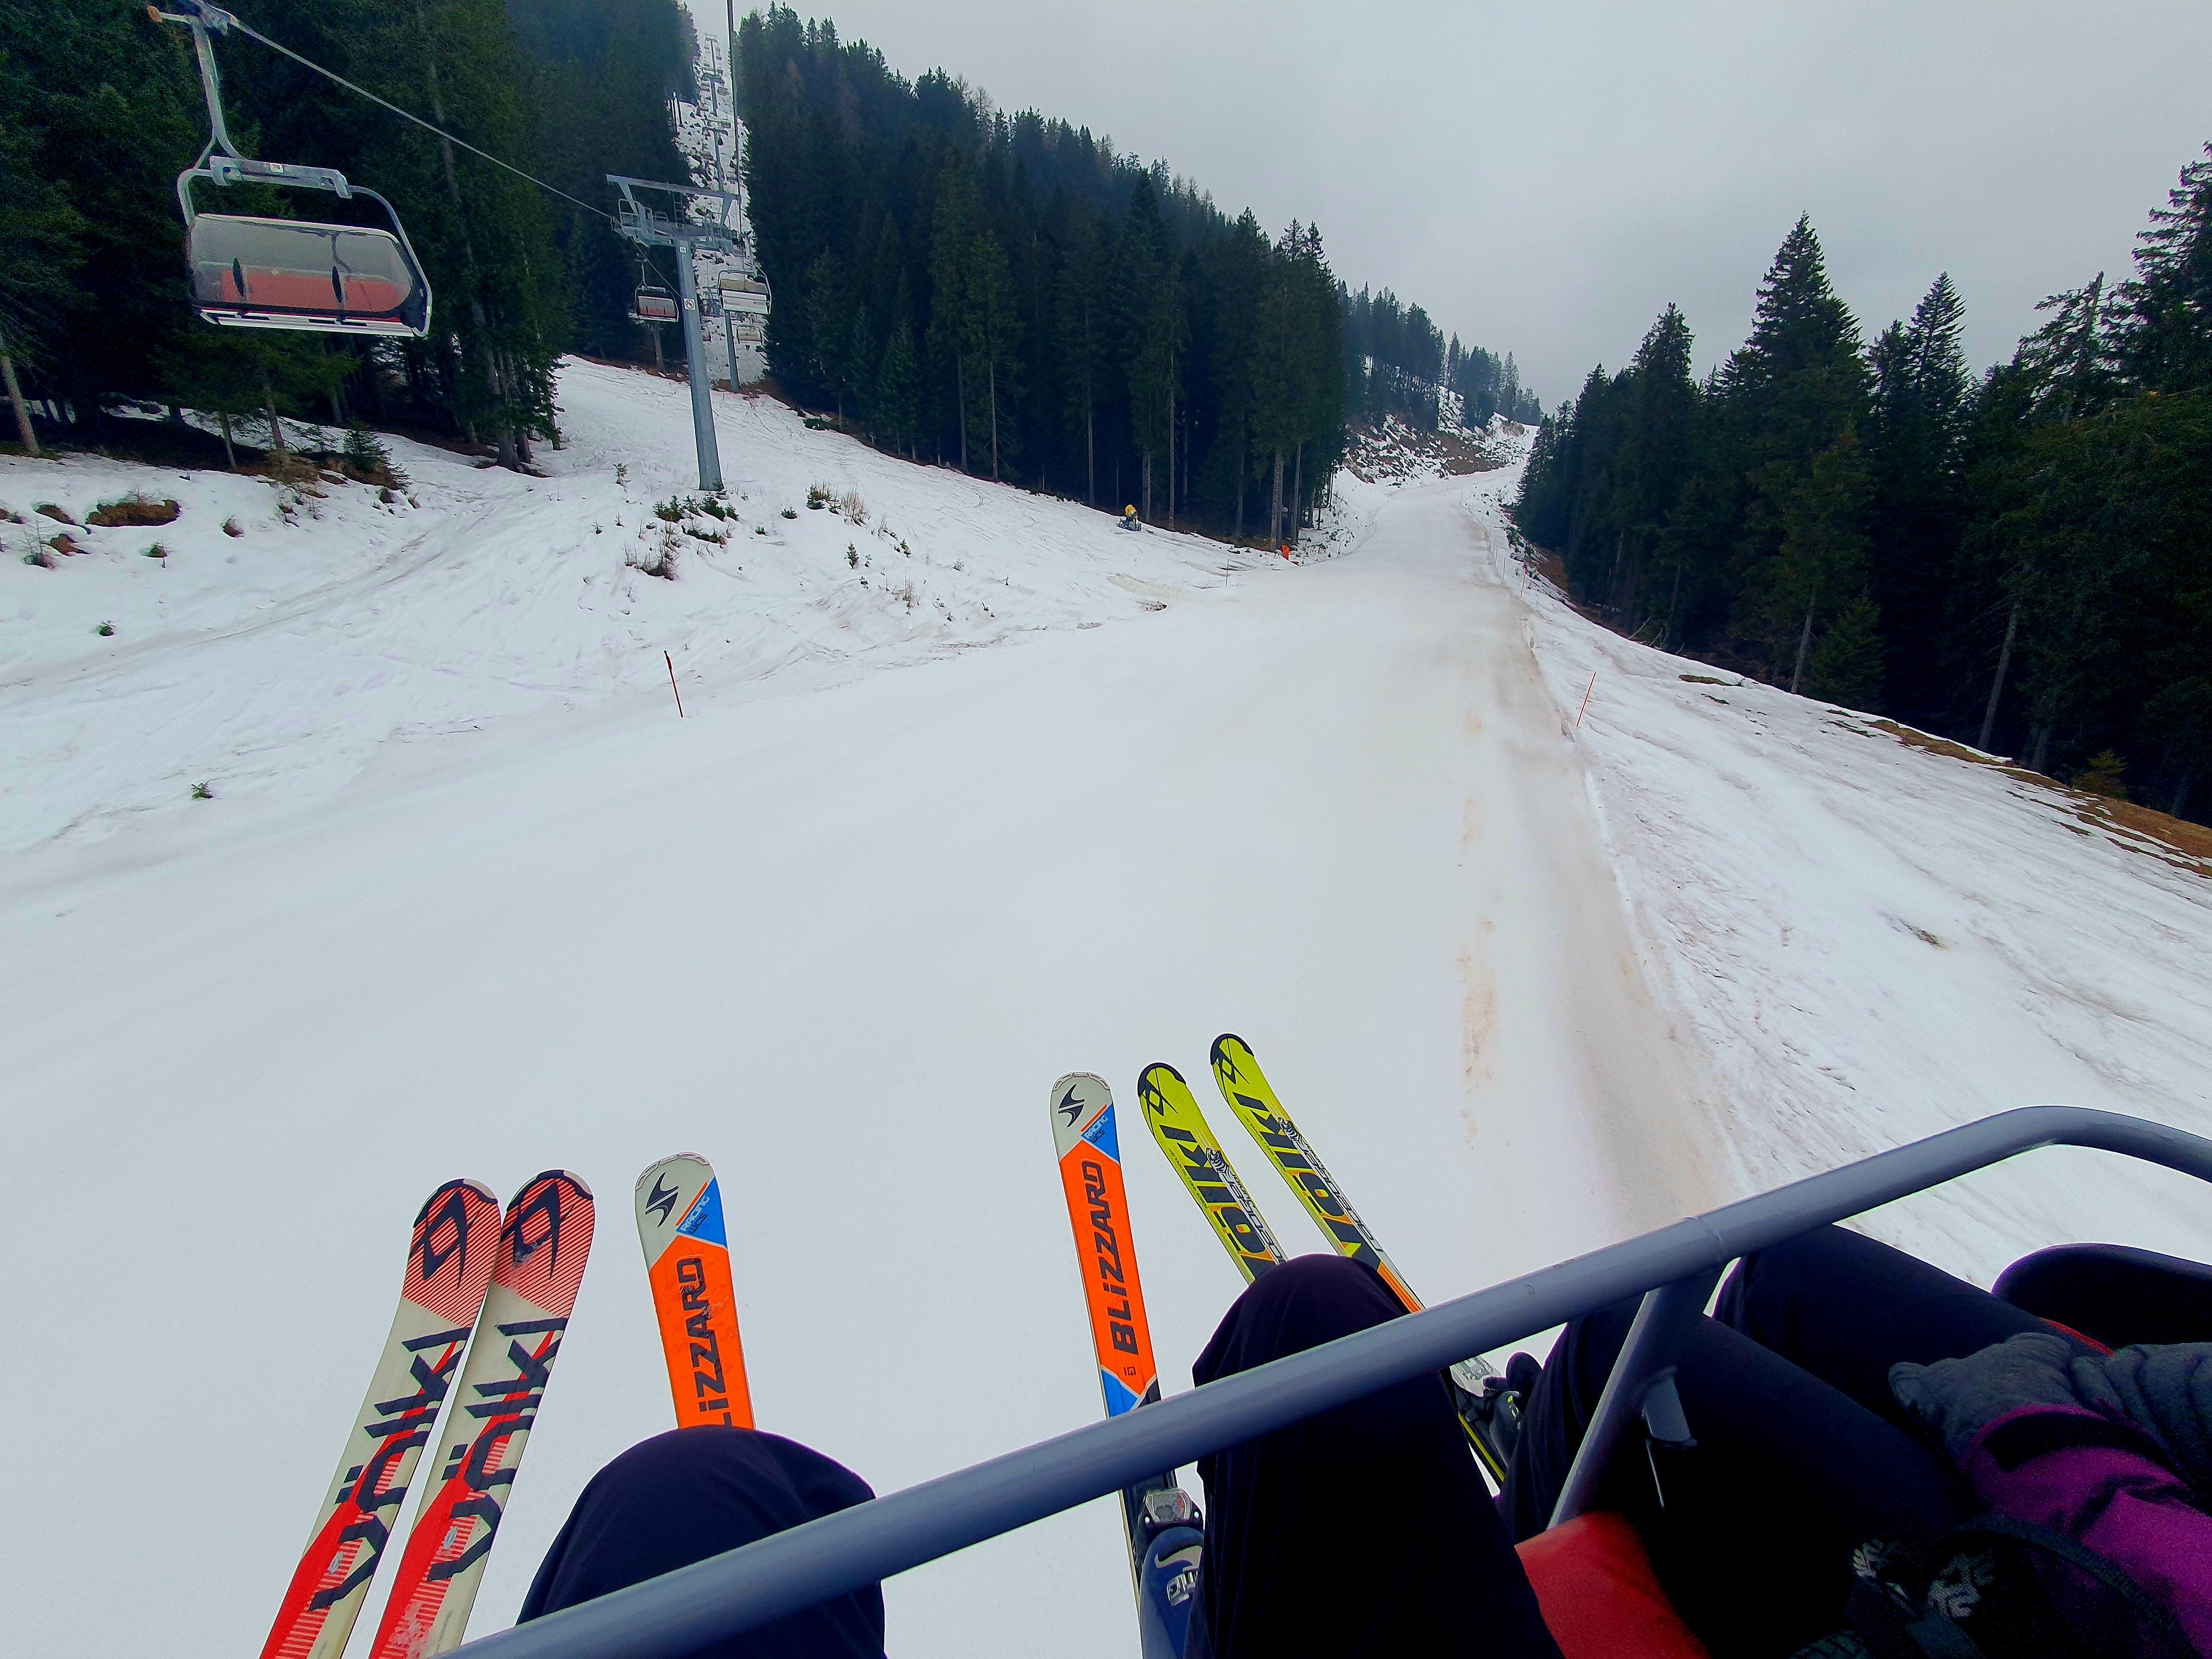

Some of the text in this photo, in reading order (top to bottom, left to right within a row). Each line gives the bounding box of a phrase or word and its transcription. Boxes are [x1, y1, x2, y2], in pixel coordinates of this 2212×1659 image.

[1084, 1115, 1108, 1139] RACING
[680, 1195, 710, 1231] RACING
[687, 1213, 708, 1234] WCS
